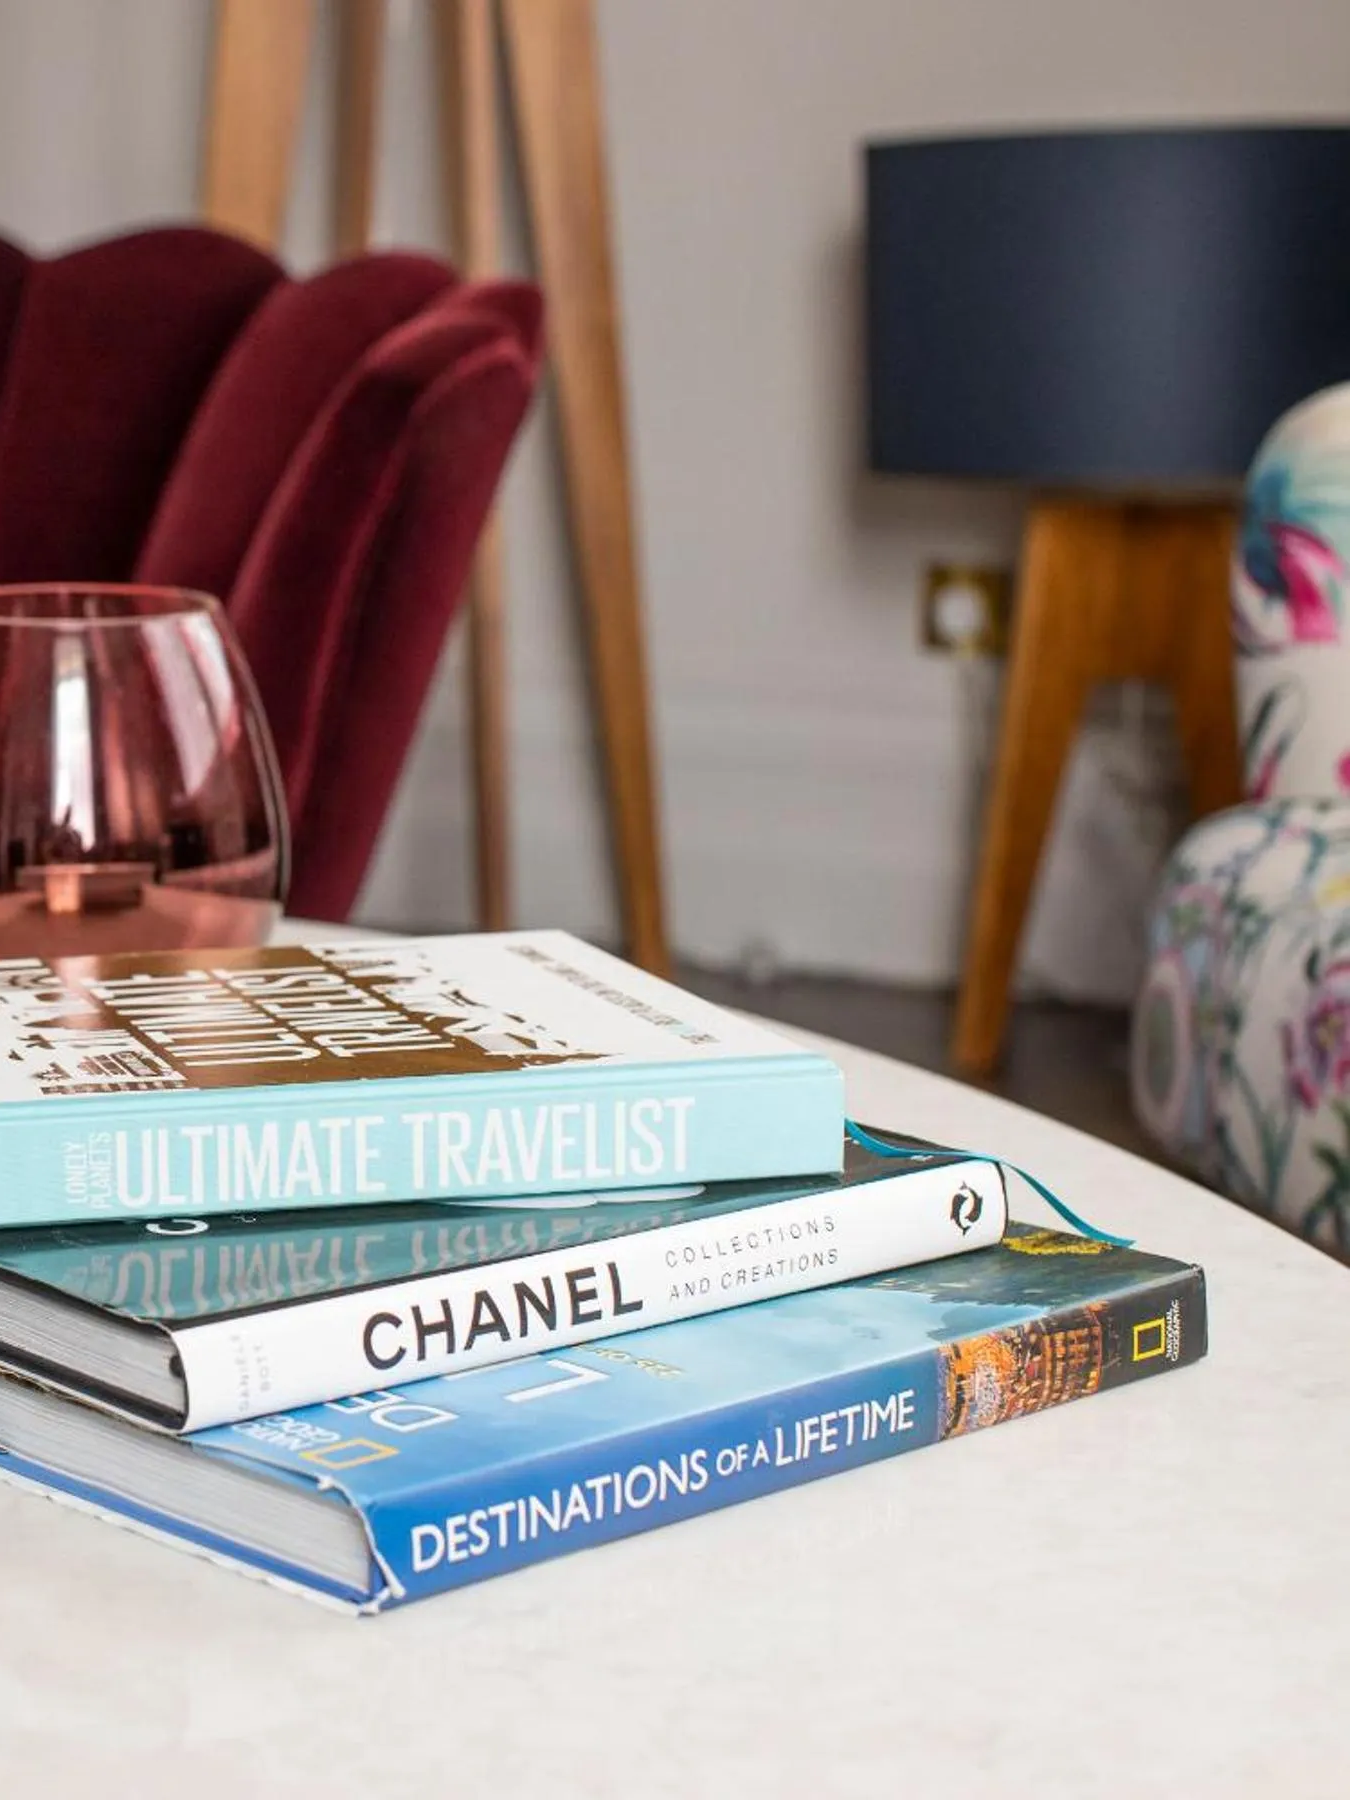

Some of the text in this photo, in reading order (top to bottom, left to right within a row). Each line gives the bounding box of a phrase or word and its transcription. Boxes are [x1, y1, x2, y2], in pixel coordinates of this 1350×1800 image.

[81, 970, 322, 1066] ULTIMATE
[209, 966, 456, 1057] TRAVELIST
[64, 1142, 87, 1204] LONELY
[116, 1098, 695, 1208] ULTIMATE TRAVELIST
[665, 1216, 836, 1268] COLLECTIONS
[669, 1249, 838, 1301] AND CREATIONS
[362, 1261, 644, 1370] CHANEL
[410, 1389, 915, 1573] DESTINATIONS OF A LIFETIME
